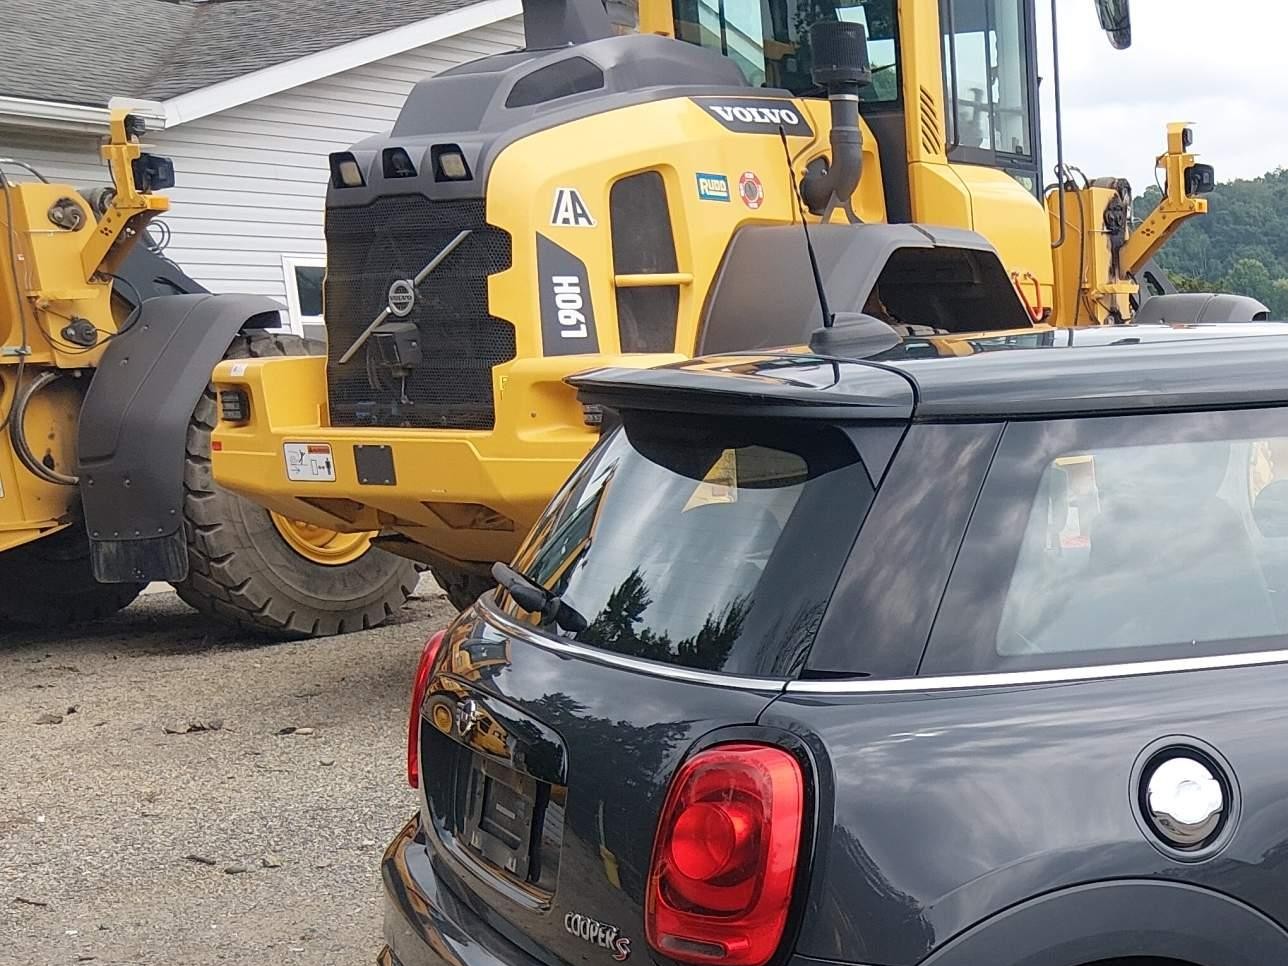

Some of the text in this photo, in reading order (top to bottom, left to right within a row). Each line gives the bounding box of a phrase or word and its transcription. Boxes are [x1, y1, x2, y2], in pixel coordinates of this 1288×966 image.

[709, 105, 799, 125] VOLVO
[699, 178, 728, 196] RUDD
[551, 275, 588, 339] L90H
[564, 912, 631, 961] COOPER S
